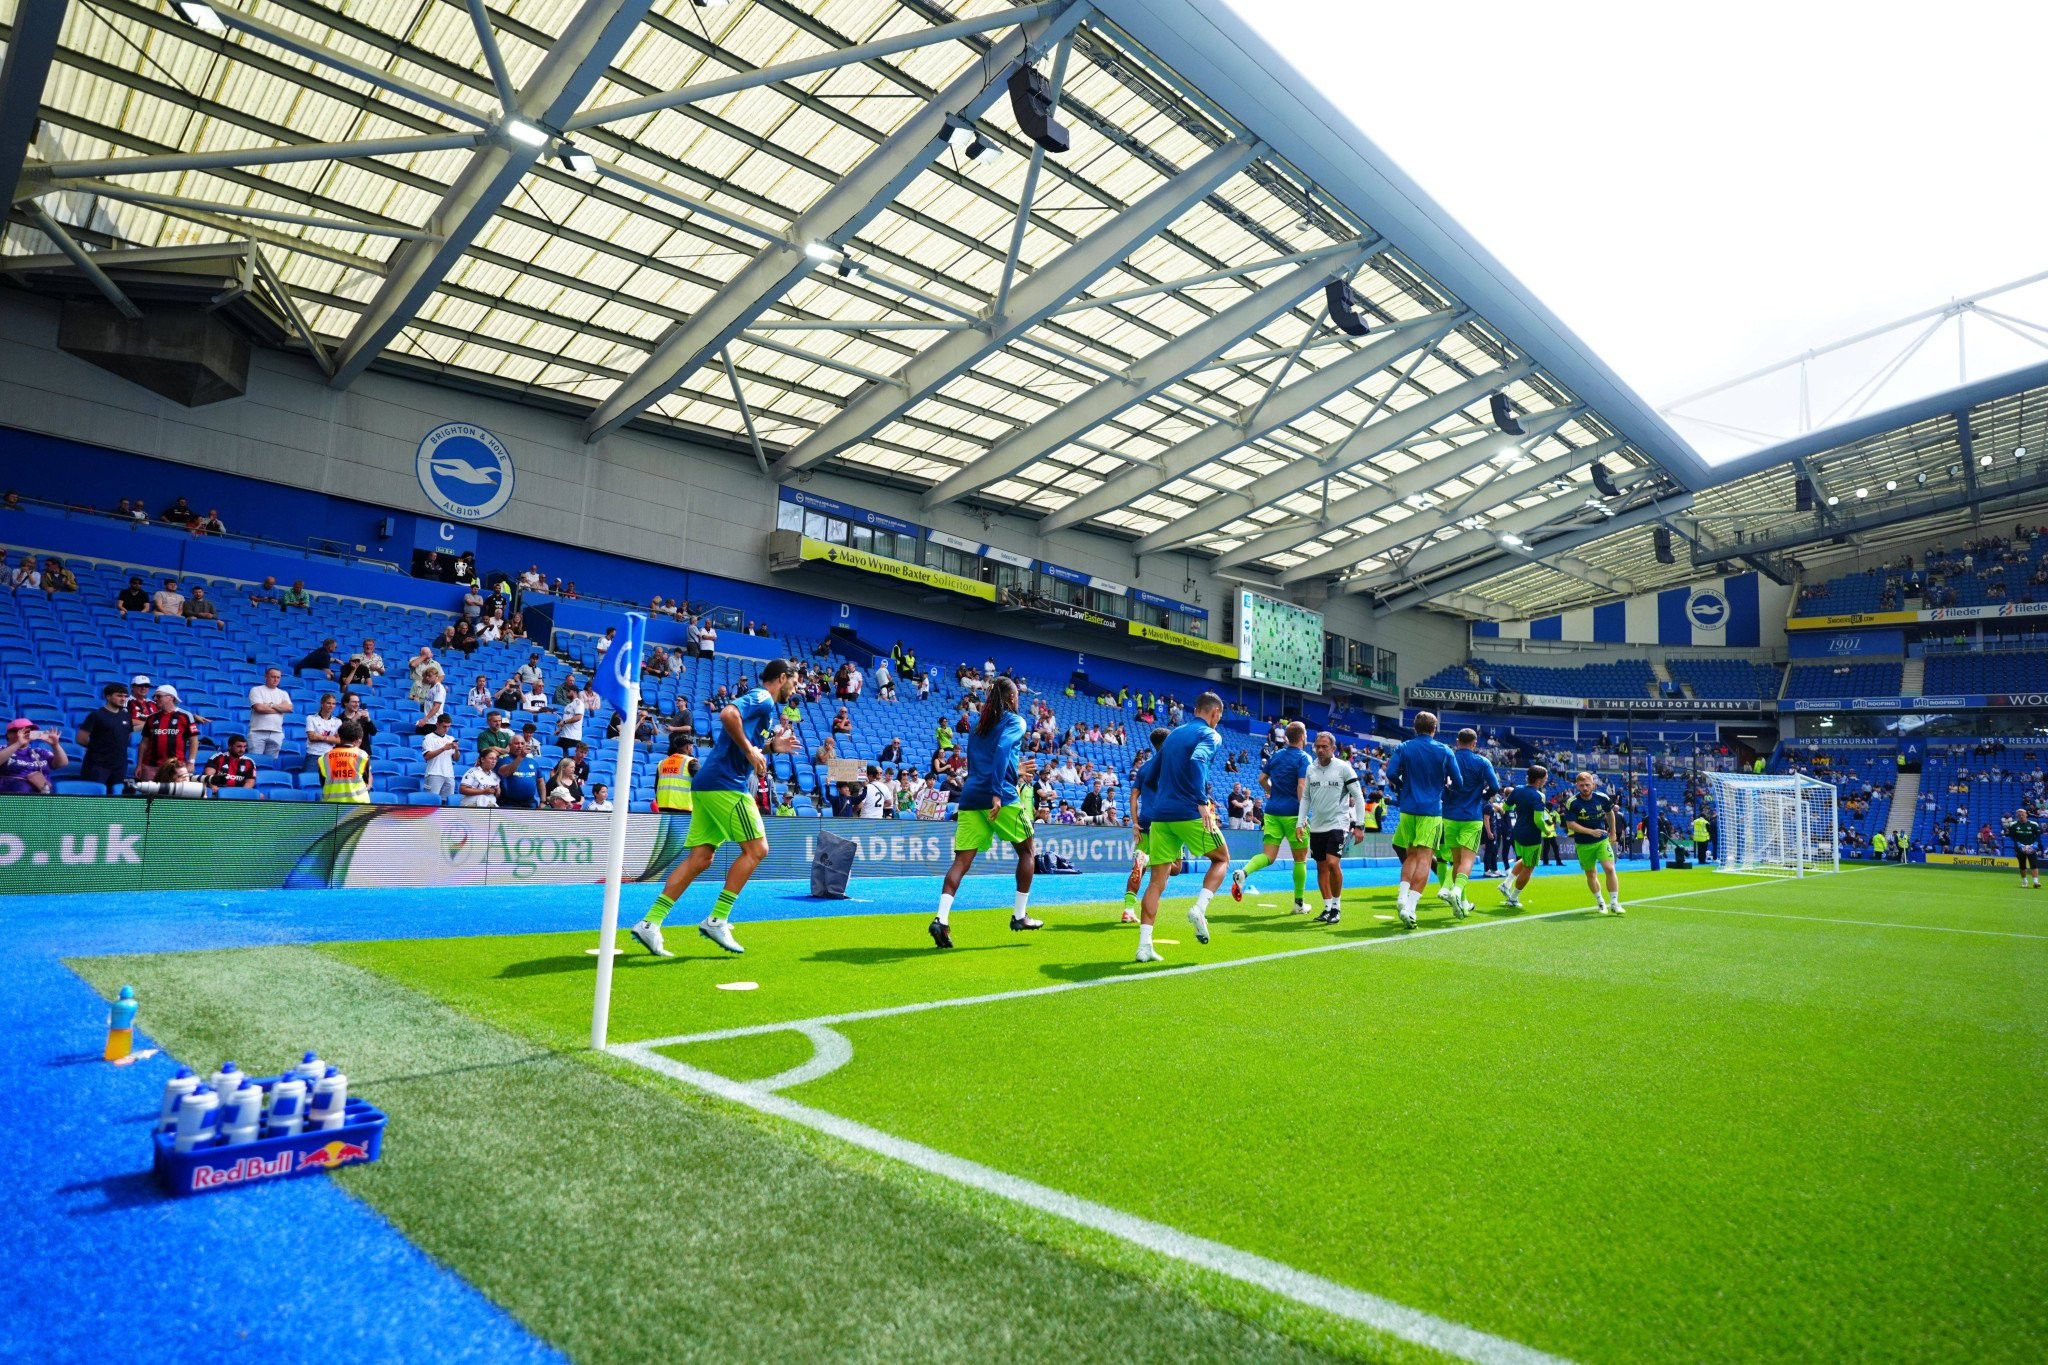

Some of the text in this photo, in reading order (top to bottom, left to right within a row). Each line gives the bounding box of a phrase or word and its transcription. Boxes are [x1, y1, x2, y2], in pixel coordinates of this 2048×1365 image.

[430, 426, 507, 461] BRIGHTON & HOVE
[443, 501, 481, 516] ALBION
[440, 522, 455, 541] C
[840, 550, 977, 593] Mayo Wynne Baxter Solicitors
[1911, 572, 1919, 580] A
[840, 603, 850, 618] D
[1053, 607, 1117, 629] www.LawEasier.co.uk
[1945, 608, 1981, 617] fileder
[1148, 628, 1164, 640] Mayo
[1164, 631, 1183, 645] Wynne
[1183, 637, 1200, 649] Baxter
[1829, 638, 1861, 650] 1901
[1078, 653, 1084, 665] E
[1412, 687, 1494, 702] SUSSEX ASPHALTE
[2009, 695, 2048, 705] WO
[1490, 727, 1496, 735] H
[328, 751, 357, 760] STEWARD
[1908, 744, 1917, 753] A
[874, 791, 882, 808] 2
[924, 789, 949, 802] JOSH
[920, 800, 935, 816] 24
[480, 821, 594, 879] Agora
[805, 836, 941, 862] LADERS
[193, 1151, 293, 1190] Red Bull
